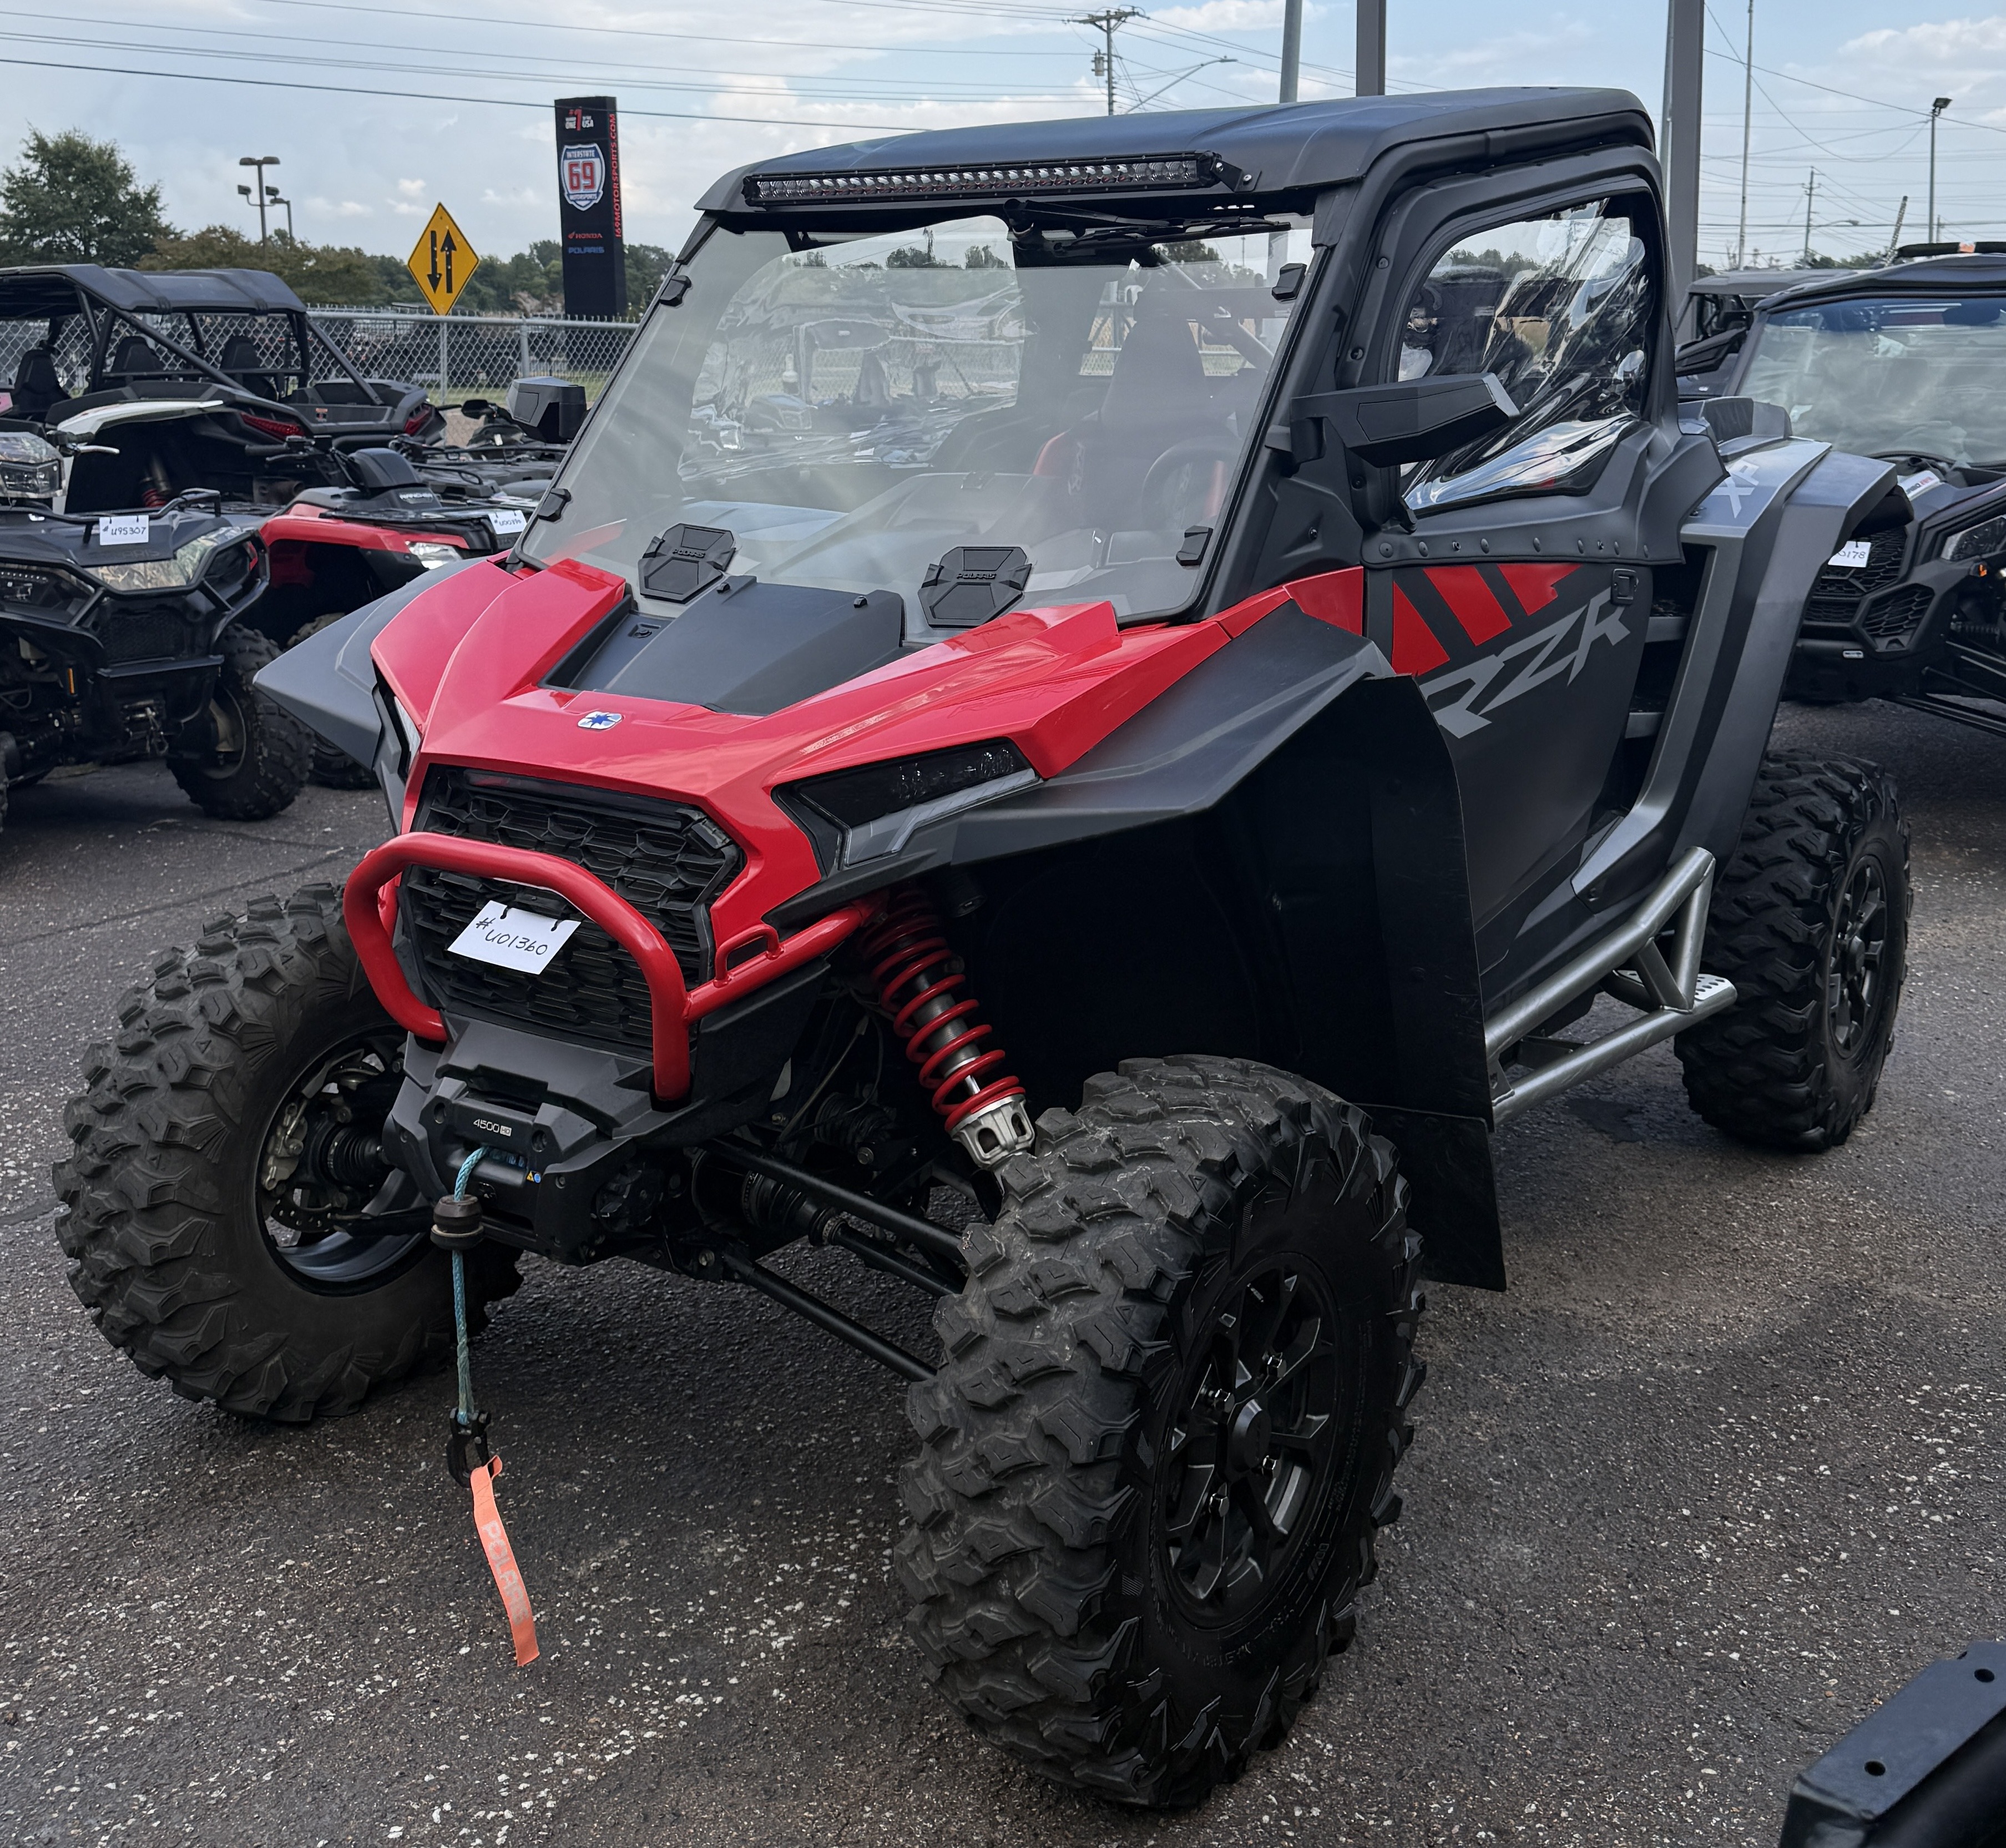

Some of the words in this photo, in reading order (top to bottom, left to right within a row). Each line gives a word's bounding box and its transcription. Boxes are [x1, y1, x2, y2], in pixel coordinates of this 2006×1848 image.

[568, 160, 595, 192] 69
[1709, 458, 1759, 518] XP
[1418, 586, 1631, 739] RZR
[473, 1119, 499, 1133] 4500
[501, 1127, 511, 1135] HD
[482, 1520, 529, 1626] POLARIS
